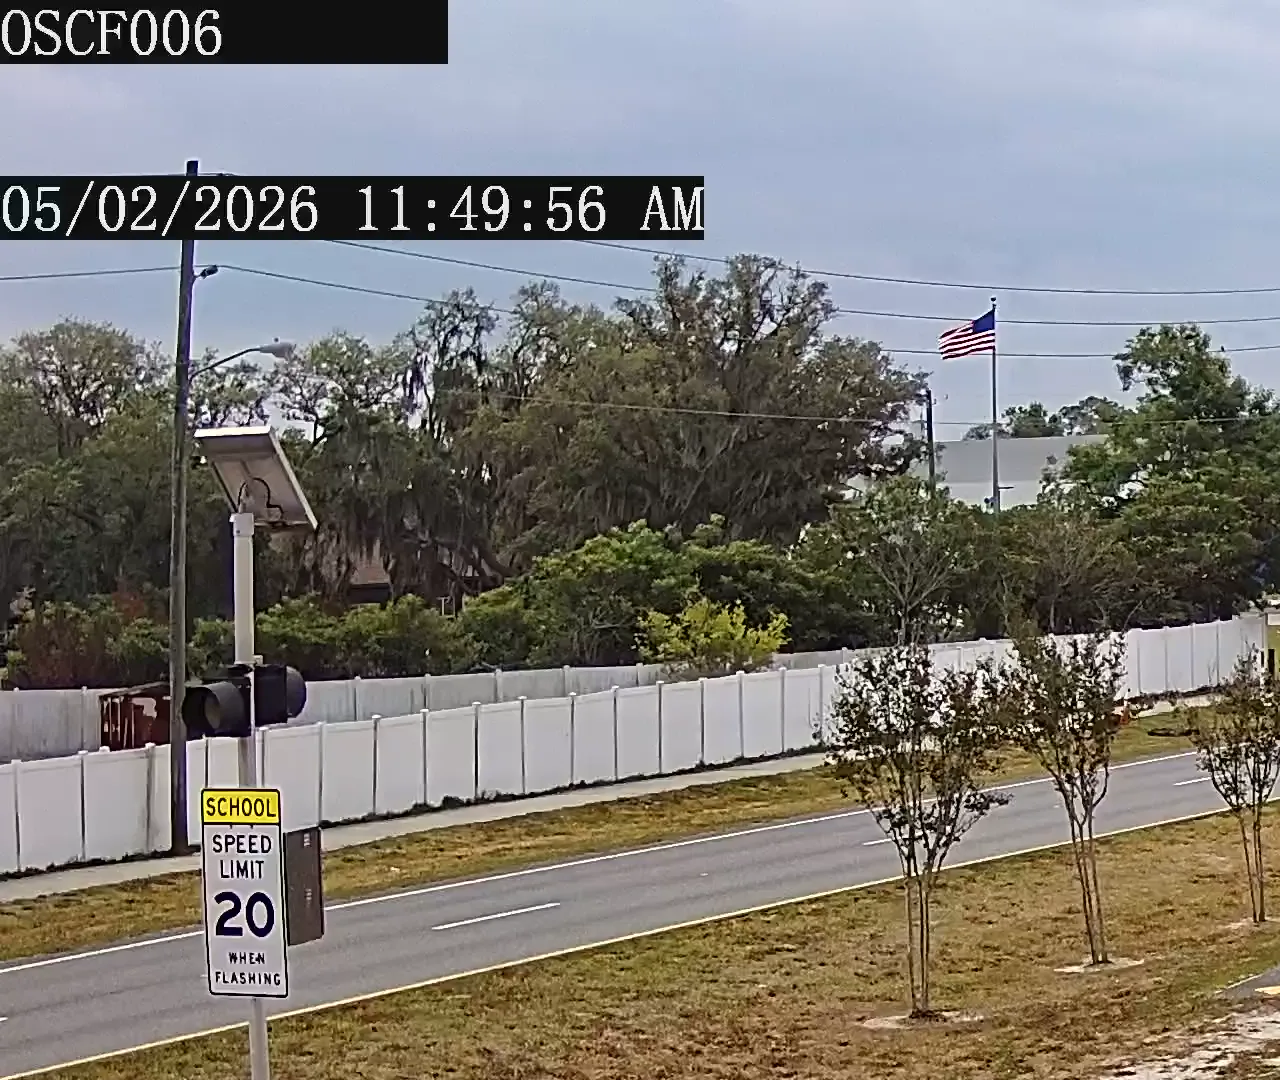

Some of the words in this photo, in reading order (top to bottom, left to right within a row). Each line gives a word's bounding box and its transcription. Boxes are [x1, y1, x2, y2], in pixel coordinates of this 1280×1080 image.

[206, 797, 276, 818] SCHOOL
[212, 834, 272, 854] SPEED
[220, 859, 265, 880] LIMIT
[213, 891, 275, 938] 20
[228, 951, 265, 965] WHEN
[215, 971, 281, 986] FLASHING
